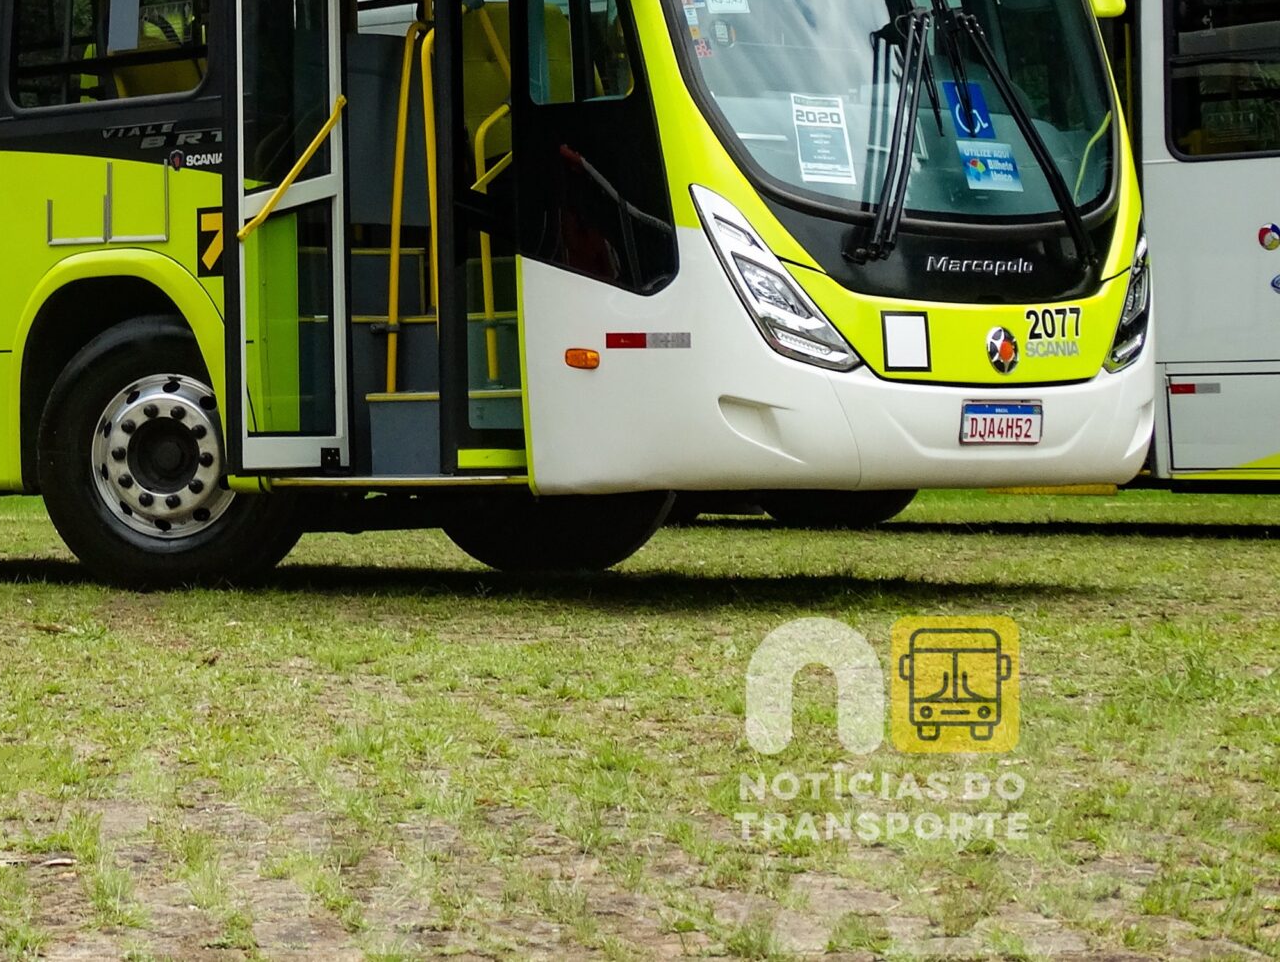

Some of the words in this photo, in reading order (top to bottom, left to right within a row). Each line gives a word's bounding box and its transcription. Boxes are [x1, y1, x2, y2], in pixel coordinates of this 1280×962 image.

[795, 109, 841, 125] 2020
[102, 123, 174, 138] VIALE
[926, 256, 1033, 276] Marcopolo
[1026, 307, 1080, 340] 2077
[1025, 341, 1080, 358] SCANIA
[969, 417, 1033, 439] DJA4H52
